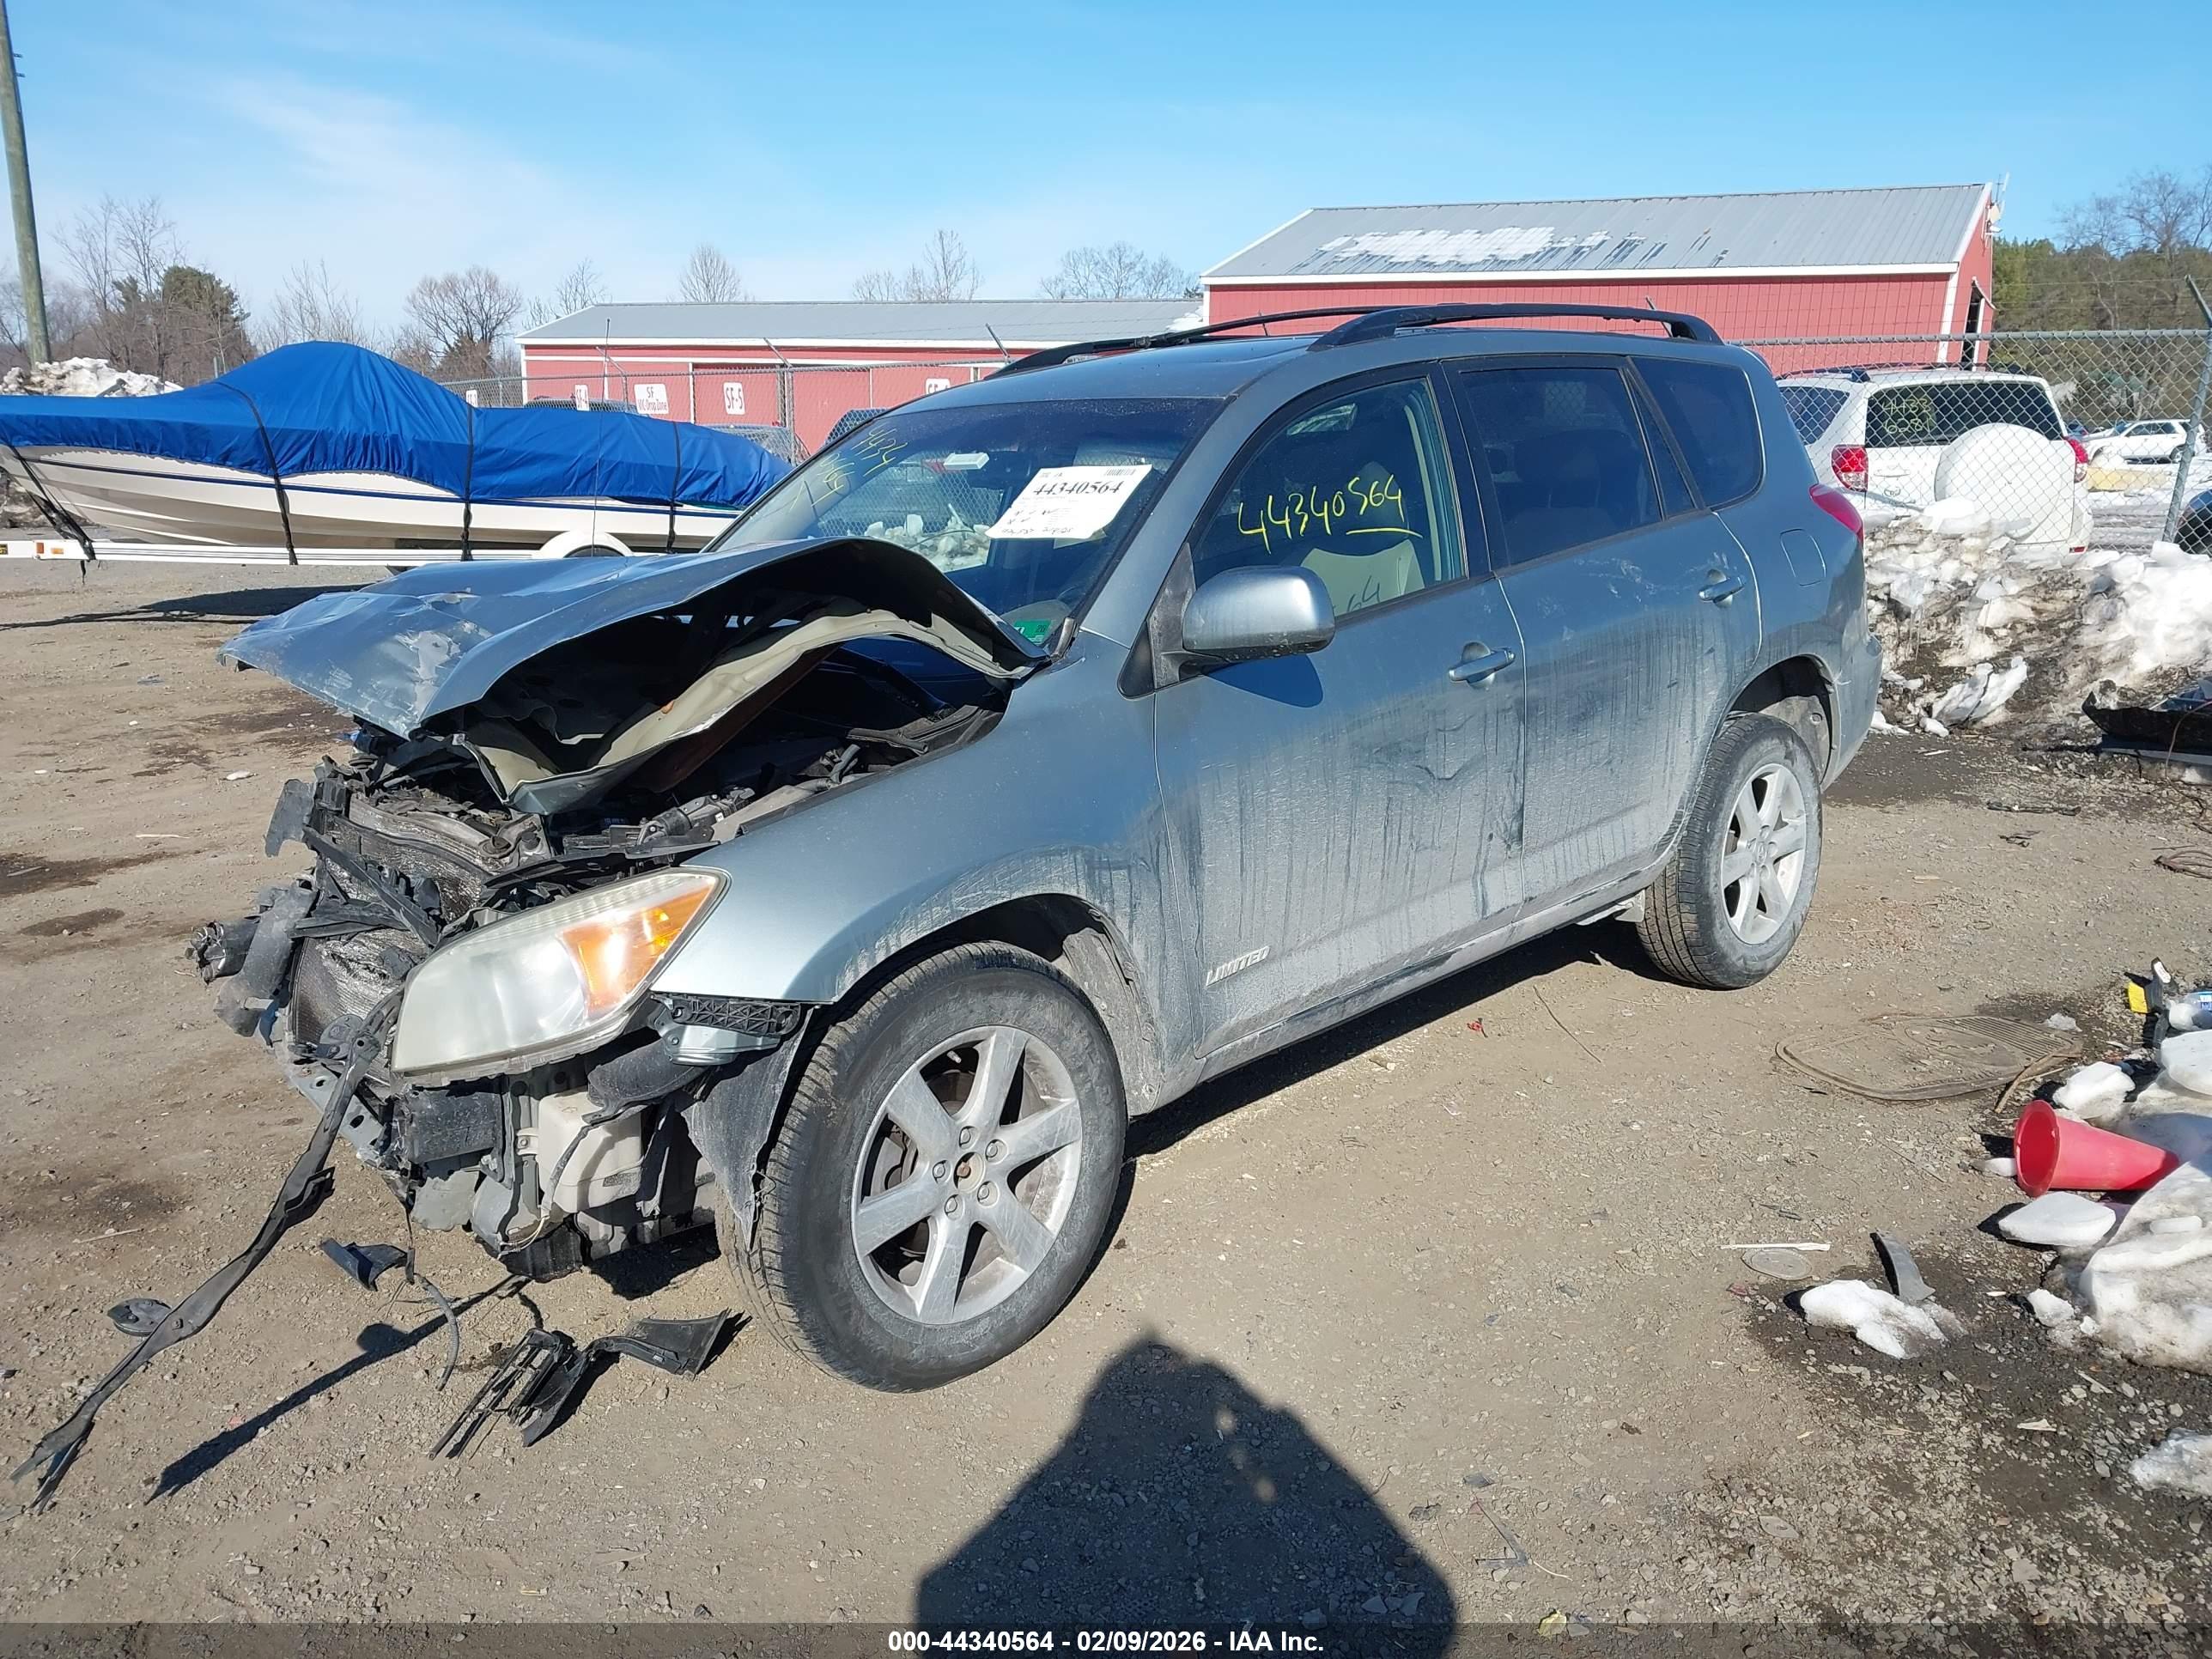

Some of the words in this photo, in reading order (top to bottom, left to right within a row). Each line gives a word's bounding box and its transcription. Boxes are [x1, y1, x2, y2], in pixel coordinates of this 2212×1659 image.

[726, 387, 744, 410] SF-5
[1033, 480, 1124, 495] 44340564
[1237, 473, 1404, 555] 44340564
[1205, 945, 1270, 988] LIMITED
